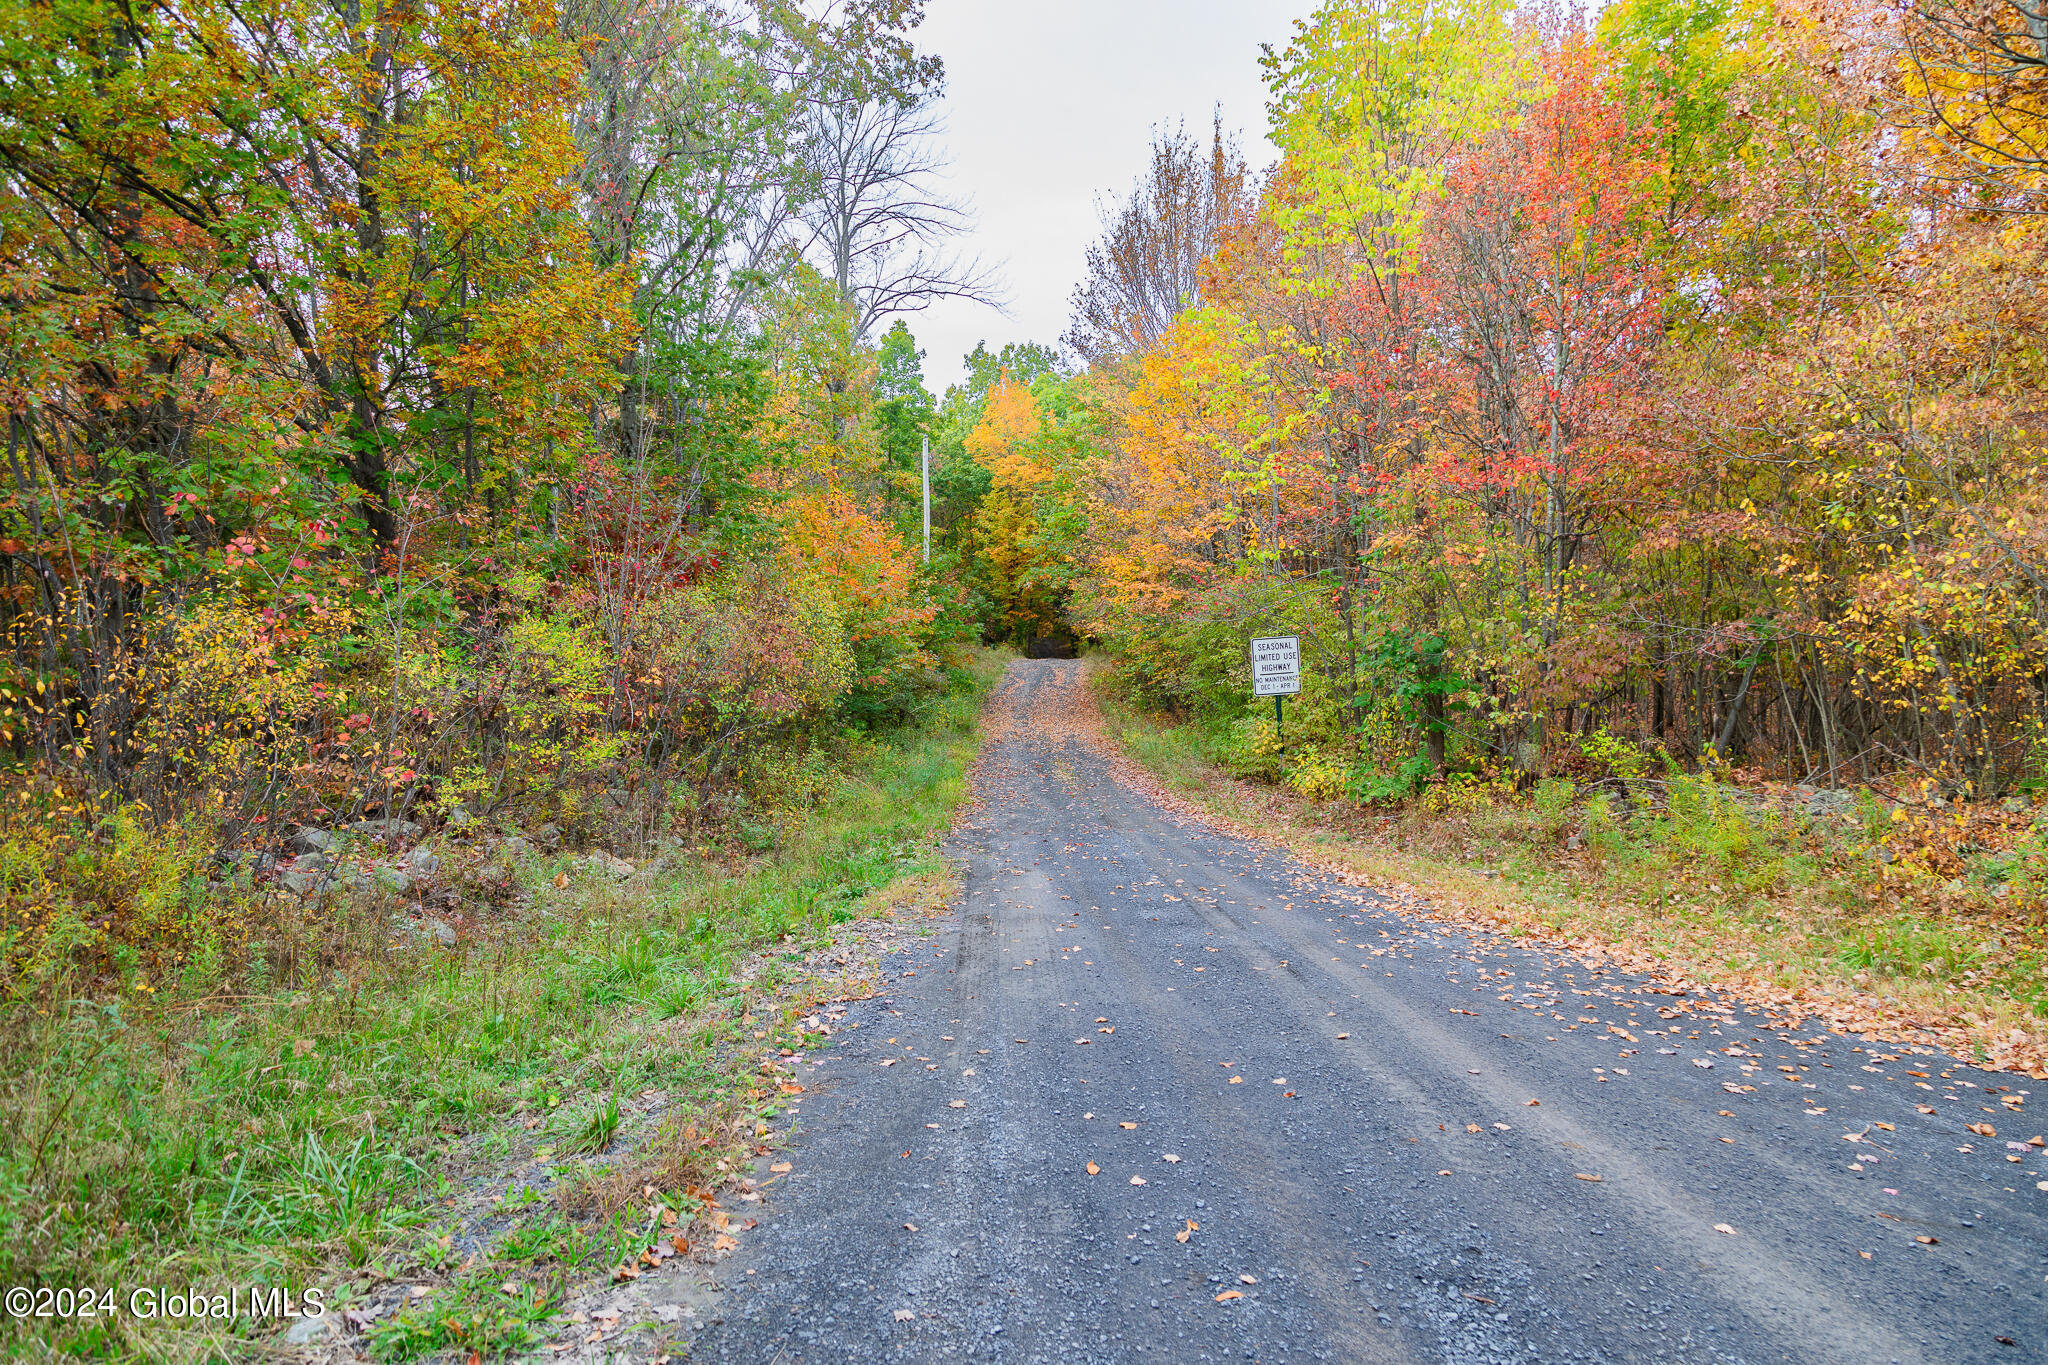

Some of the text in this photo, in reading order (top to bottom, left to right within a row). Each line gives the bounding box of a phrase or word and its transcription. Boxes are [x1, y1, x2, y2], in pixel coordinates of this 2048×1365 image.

[1257, 642, 1293, 651] SEASONAL
[1255, 652, 1297, 662] LIMITED USE
[1261, 663, 1291, 672] HIGHWAY
